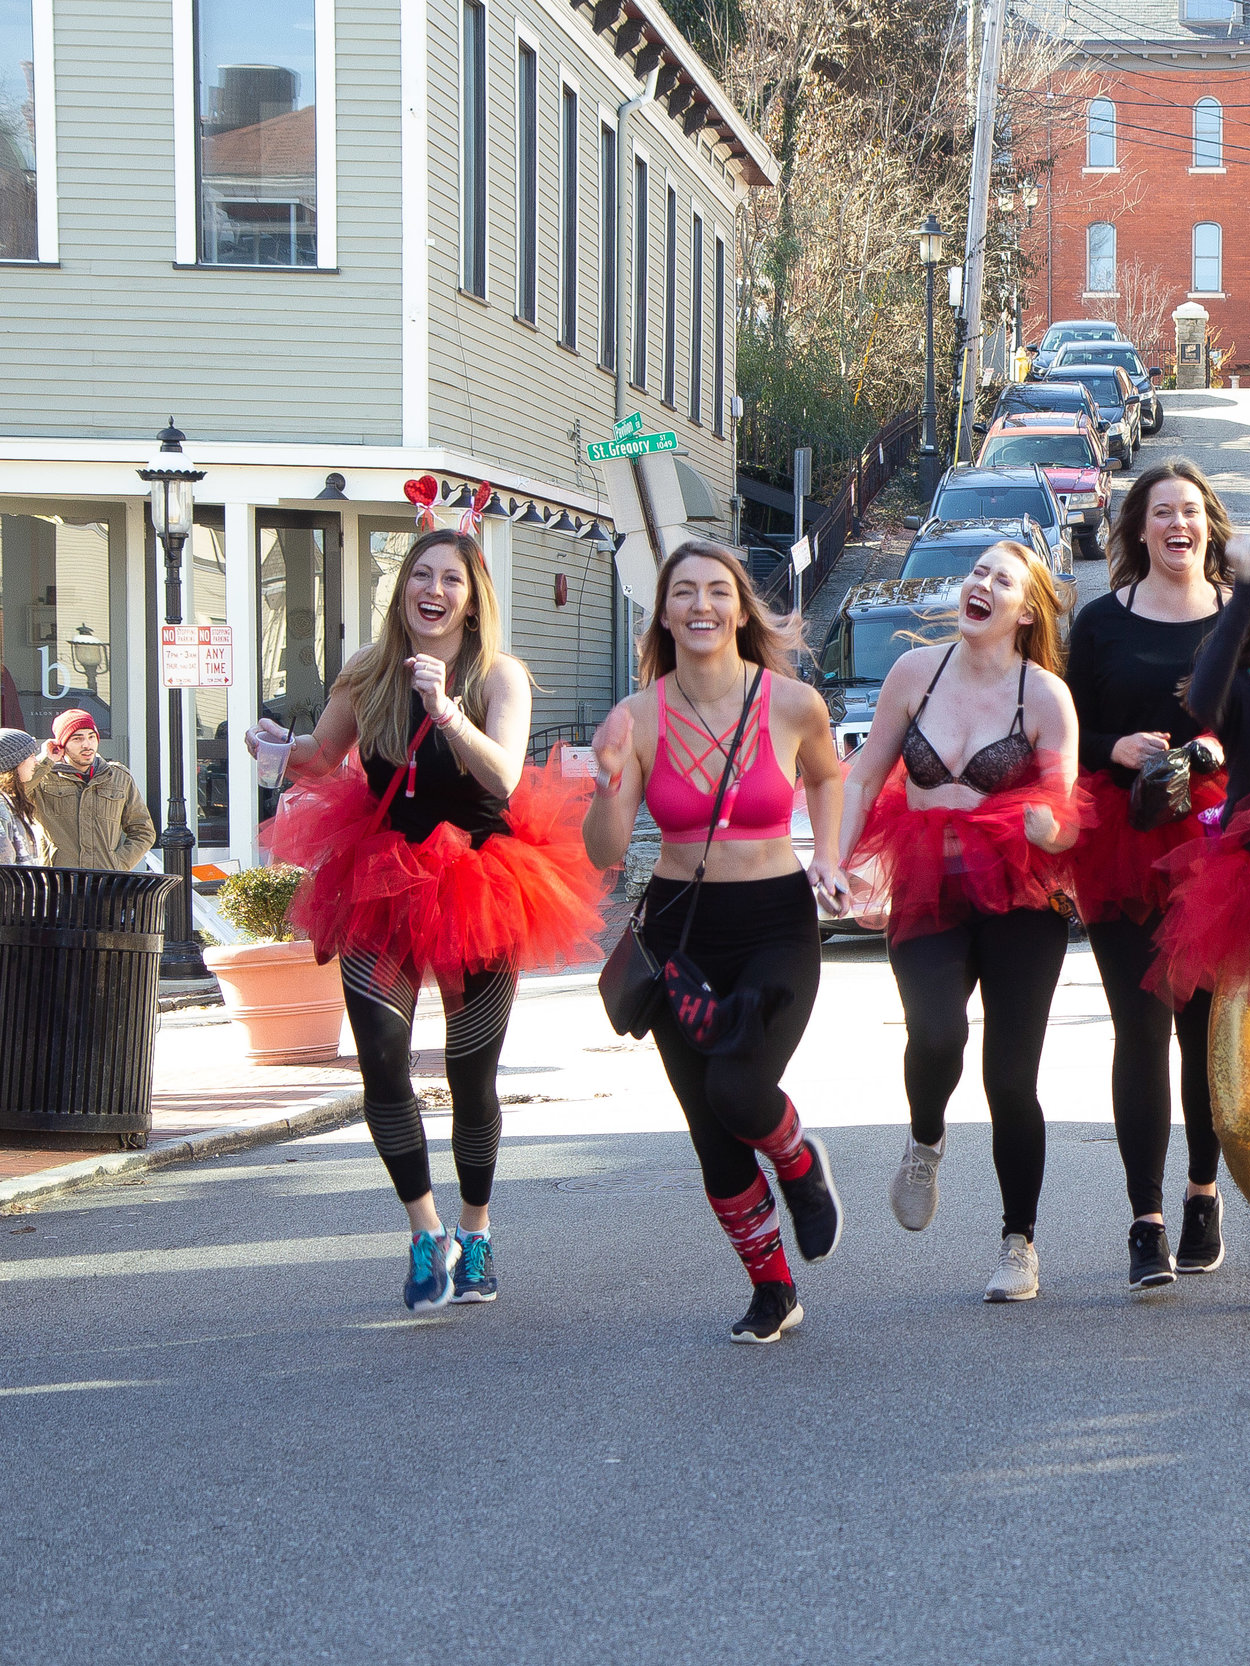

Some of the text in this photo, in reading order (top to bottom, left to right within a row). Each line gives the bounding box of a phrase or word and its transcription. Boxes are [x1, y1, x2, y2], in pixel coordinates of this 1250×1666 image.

[608, 440, 650, 456] Gregory
[656, 440, 673, 450] 1049
[163, 629, 175, 642] NO
[199, 629, 211, 642] NO
[206, 648, 224, 659] ANY
[37, 645, 71, 700] b
[205, 662, 226, 674] TIME
